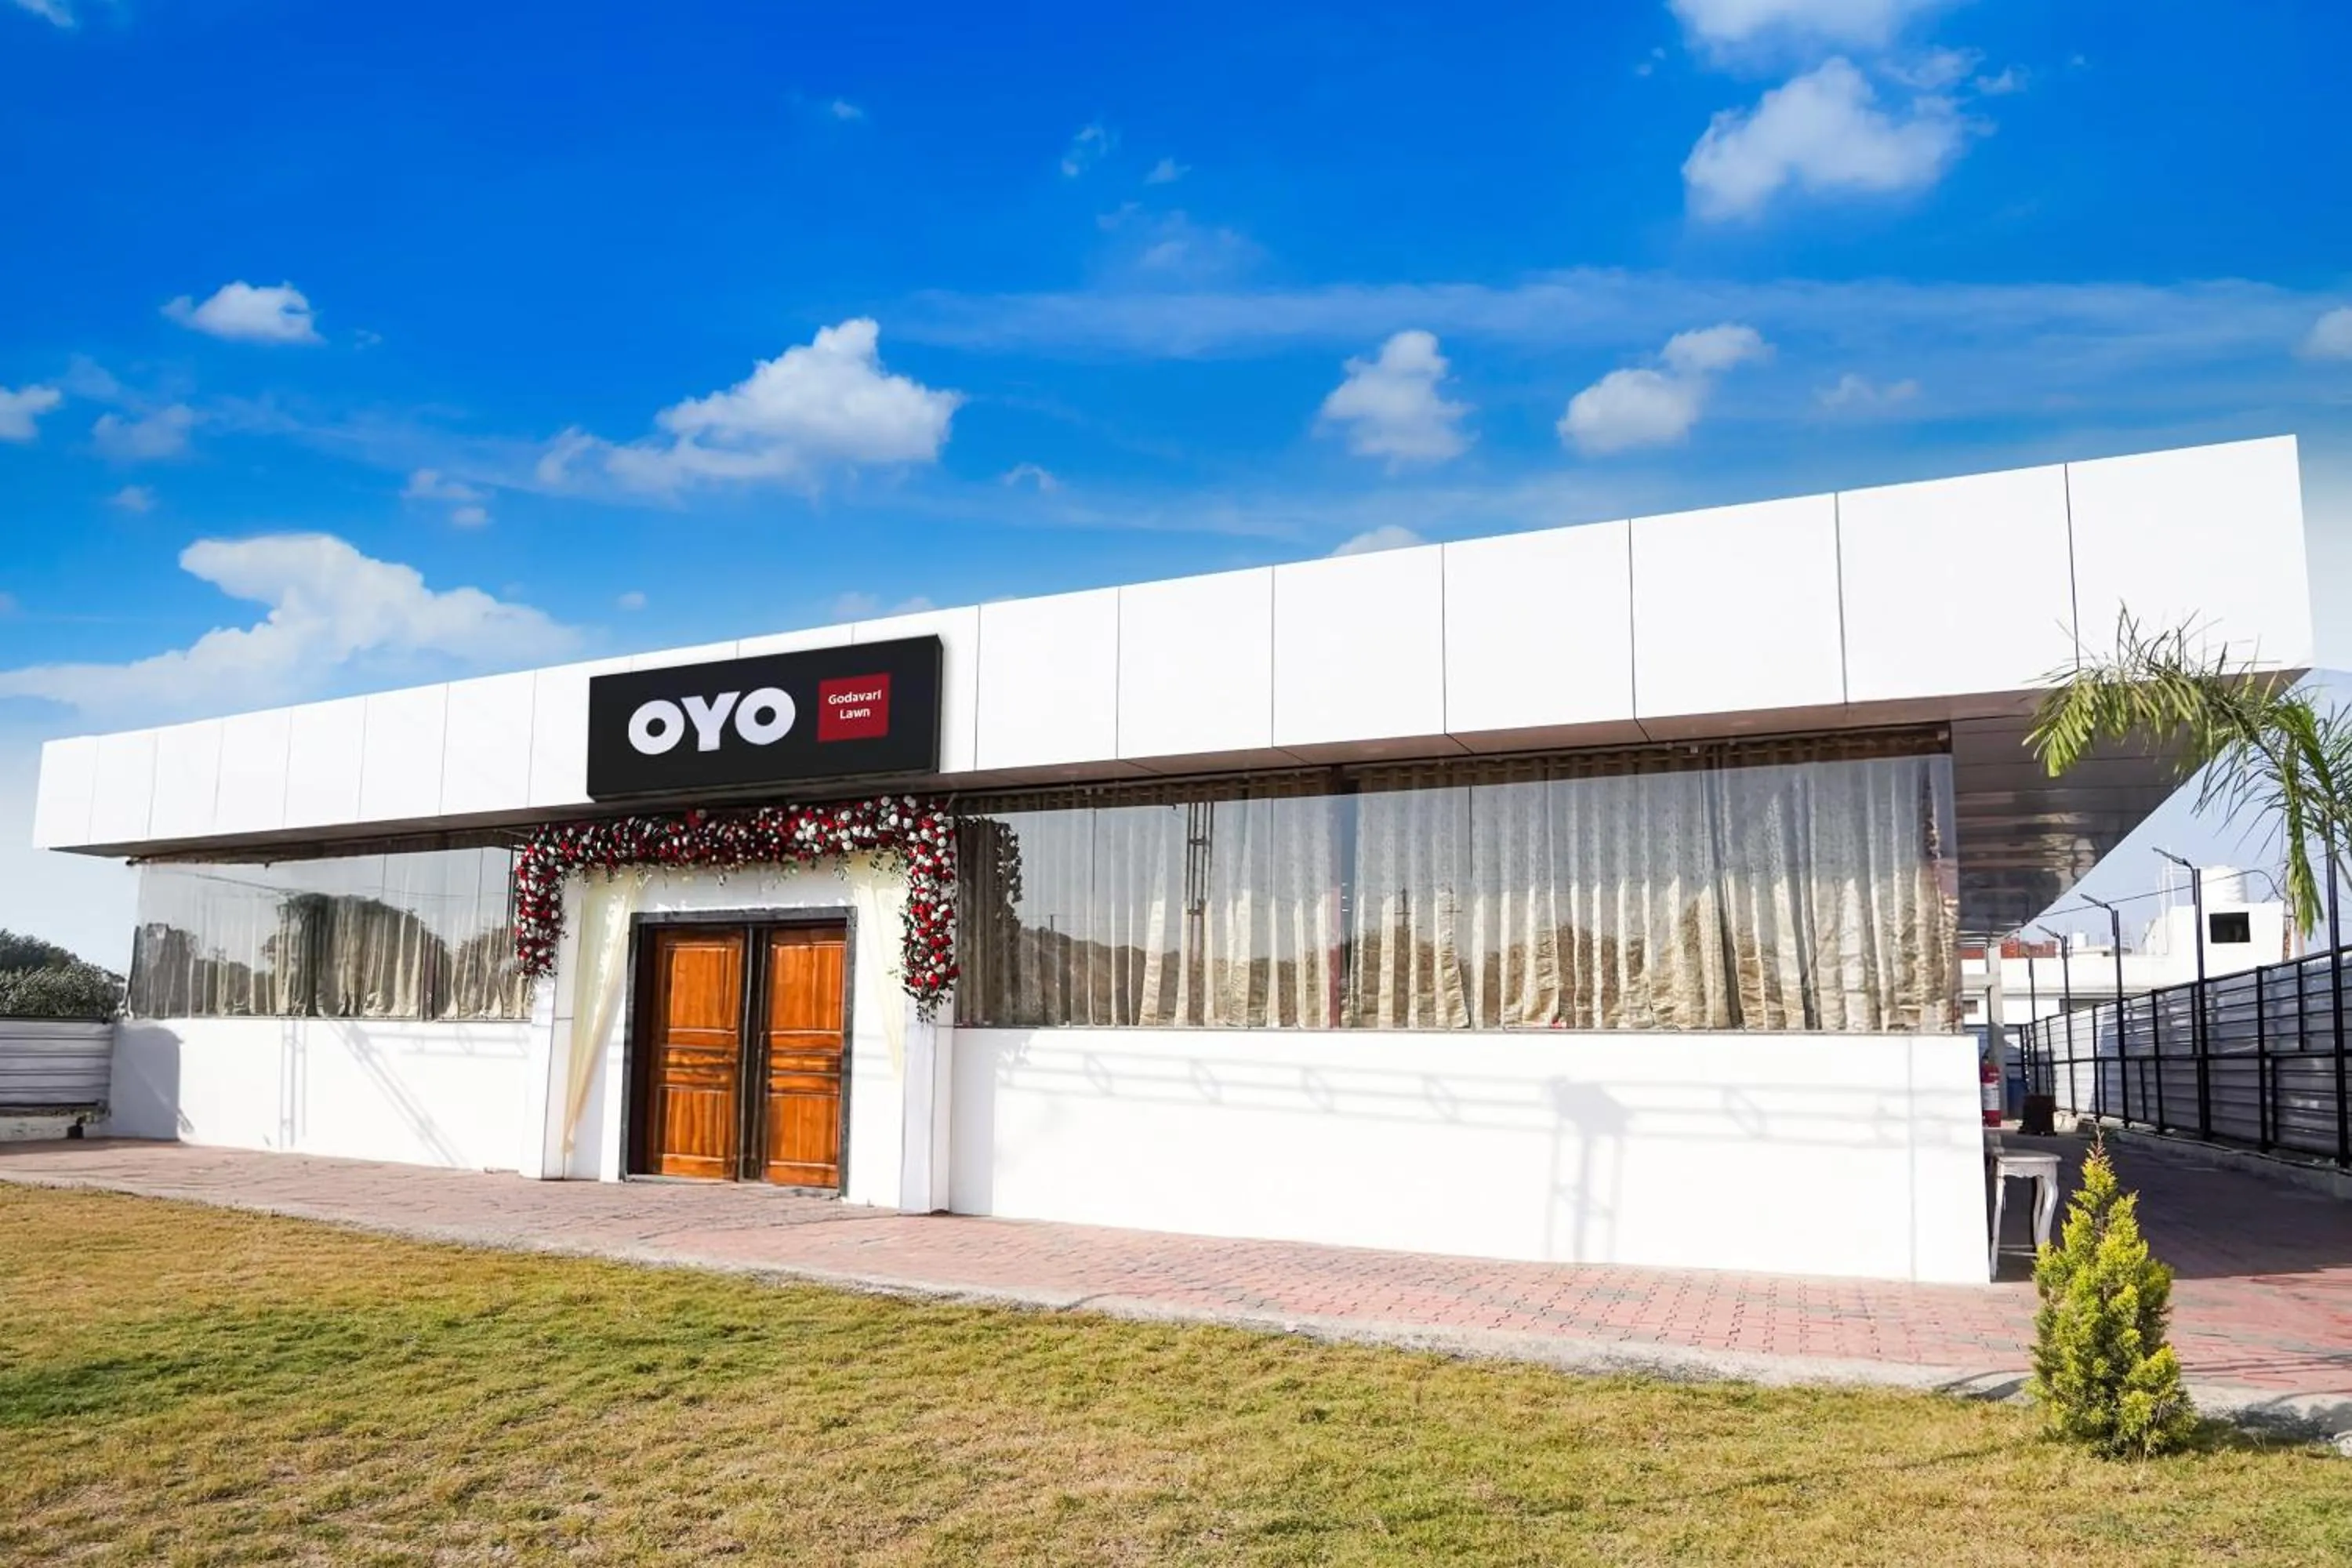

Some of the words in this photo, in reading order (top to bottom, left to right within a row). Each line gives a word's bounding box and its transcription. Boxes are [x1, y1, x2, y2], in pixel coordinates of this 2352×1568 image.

[828, 689, 882, 705] Godavari
[628, 687, 796, 755] OYO
[840, 707, 870, 720] Lawn
